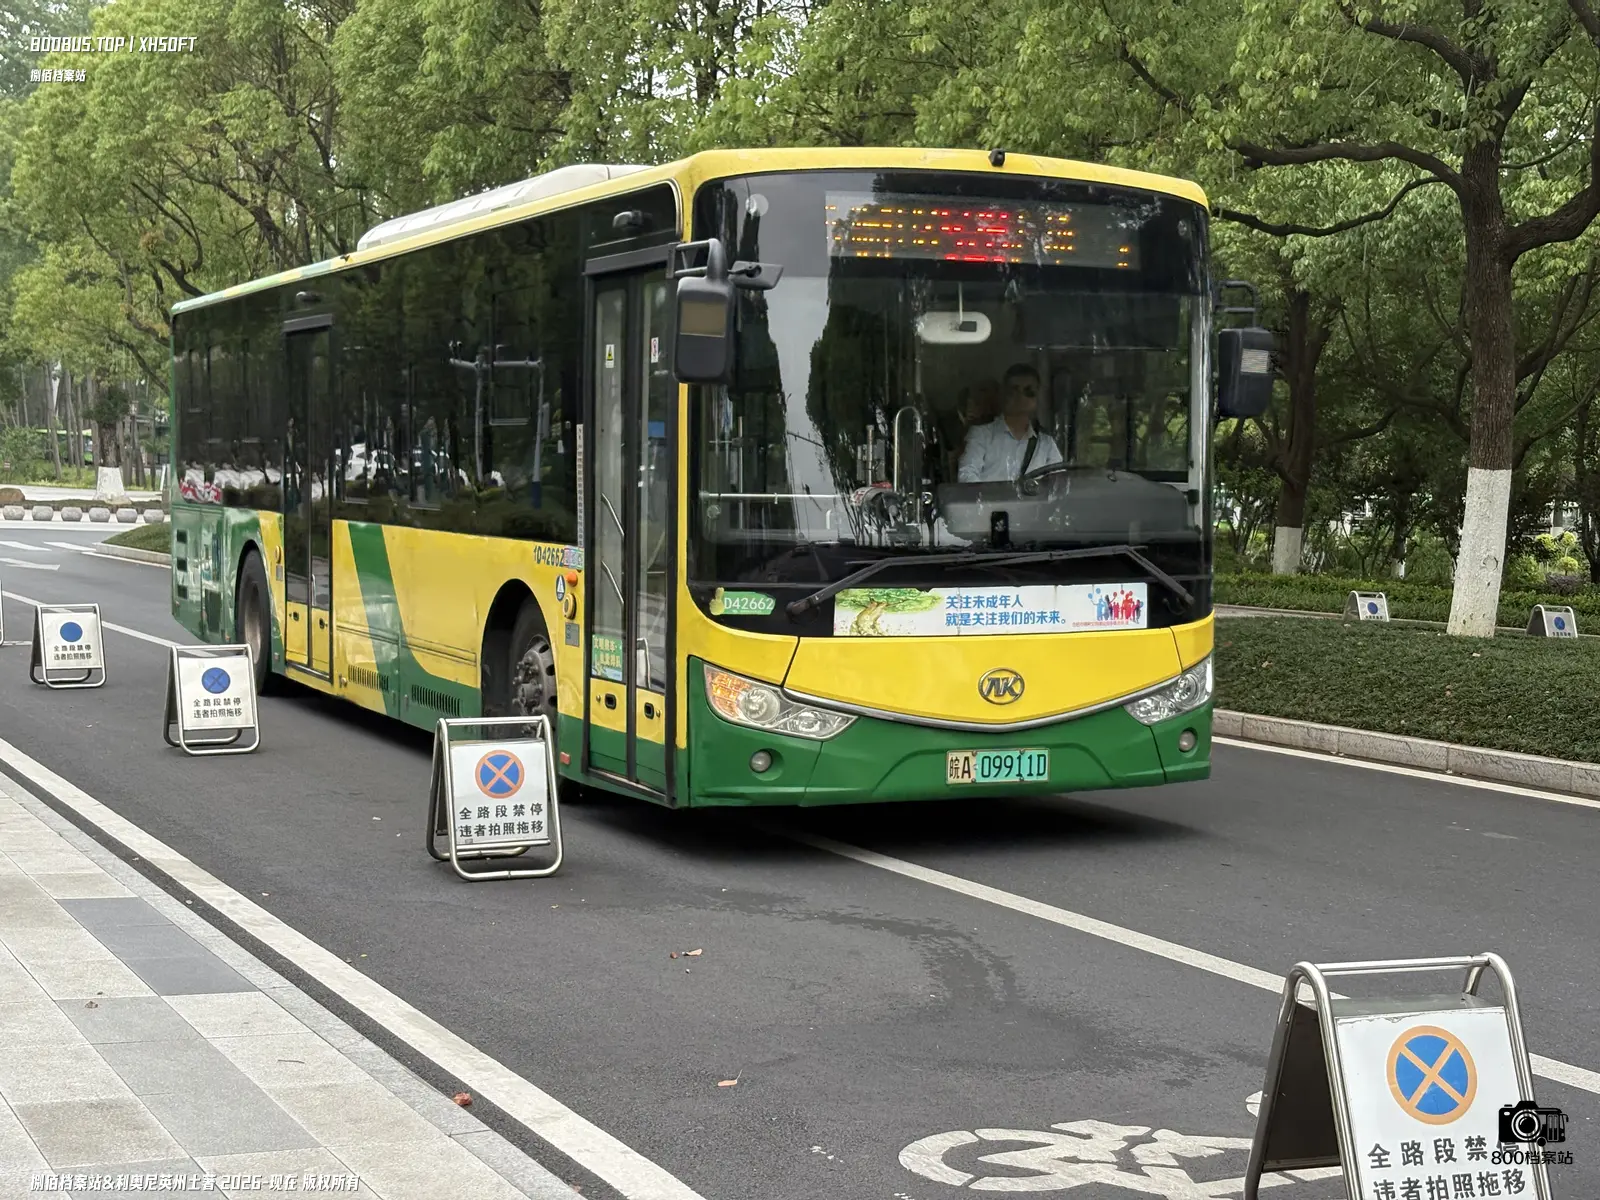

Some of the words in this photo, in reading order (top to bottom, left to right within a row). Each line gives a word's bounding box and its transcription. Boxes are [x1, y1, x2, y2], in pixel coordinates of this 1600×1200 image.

[724, 597, 775, 610] D42662
[945, 594, 1023, 609] 关注未成年人
[945, 611, 1066, 626] 就是关注我们的未来。
[193, 697, 241, 707] 全路段禁停
[193, 708, 242, 718] 违者拍照拖移
[459, 803, 543, 820] 全路段禁停
[459, 820, 544, 837] 违者拍照拖移
[1373, 1168, 1526, 1200] 违者拍照拖移
